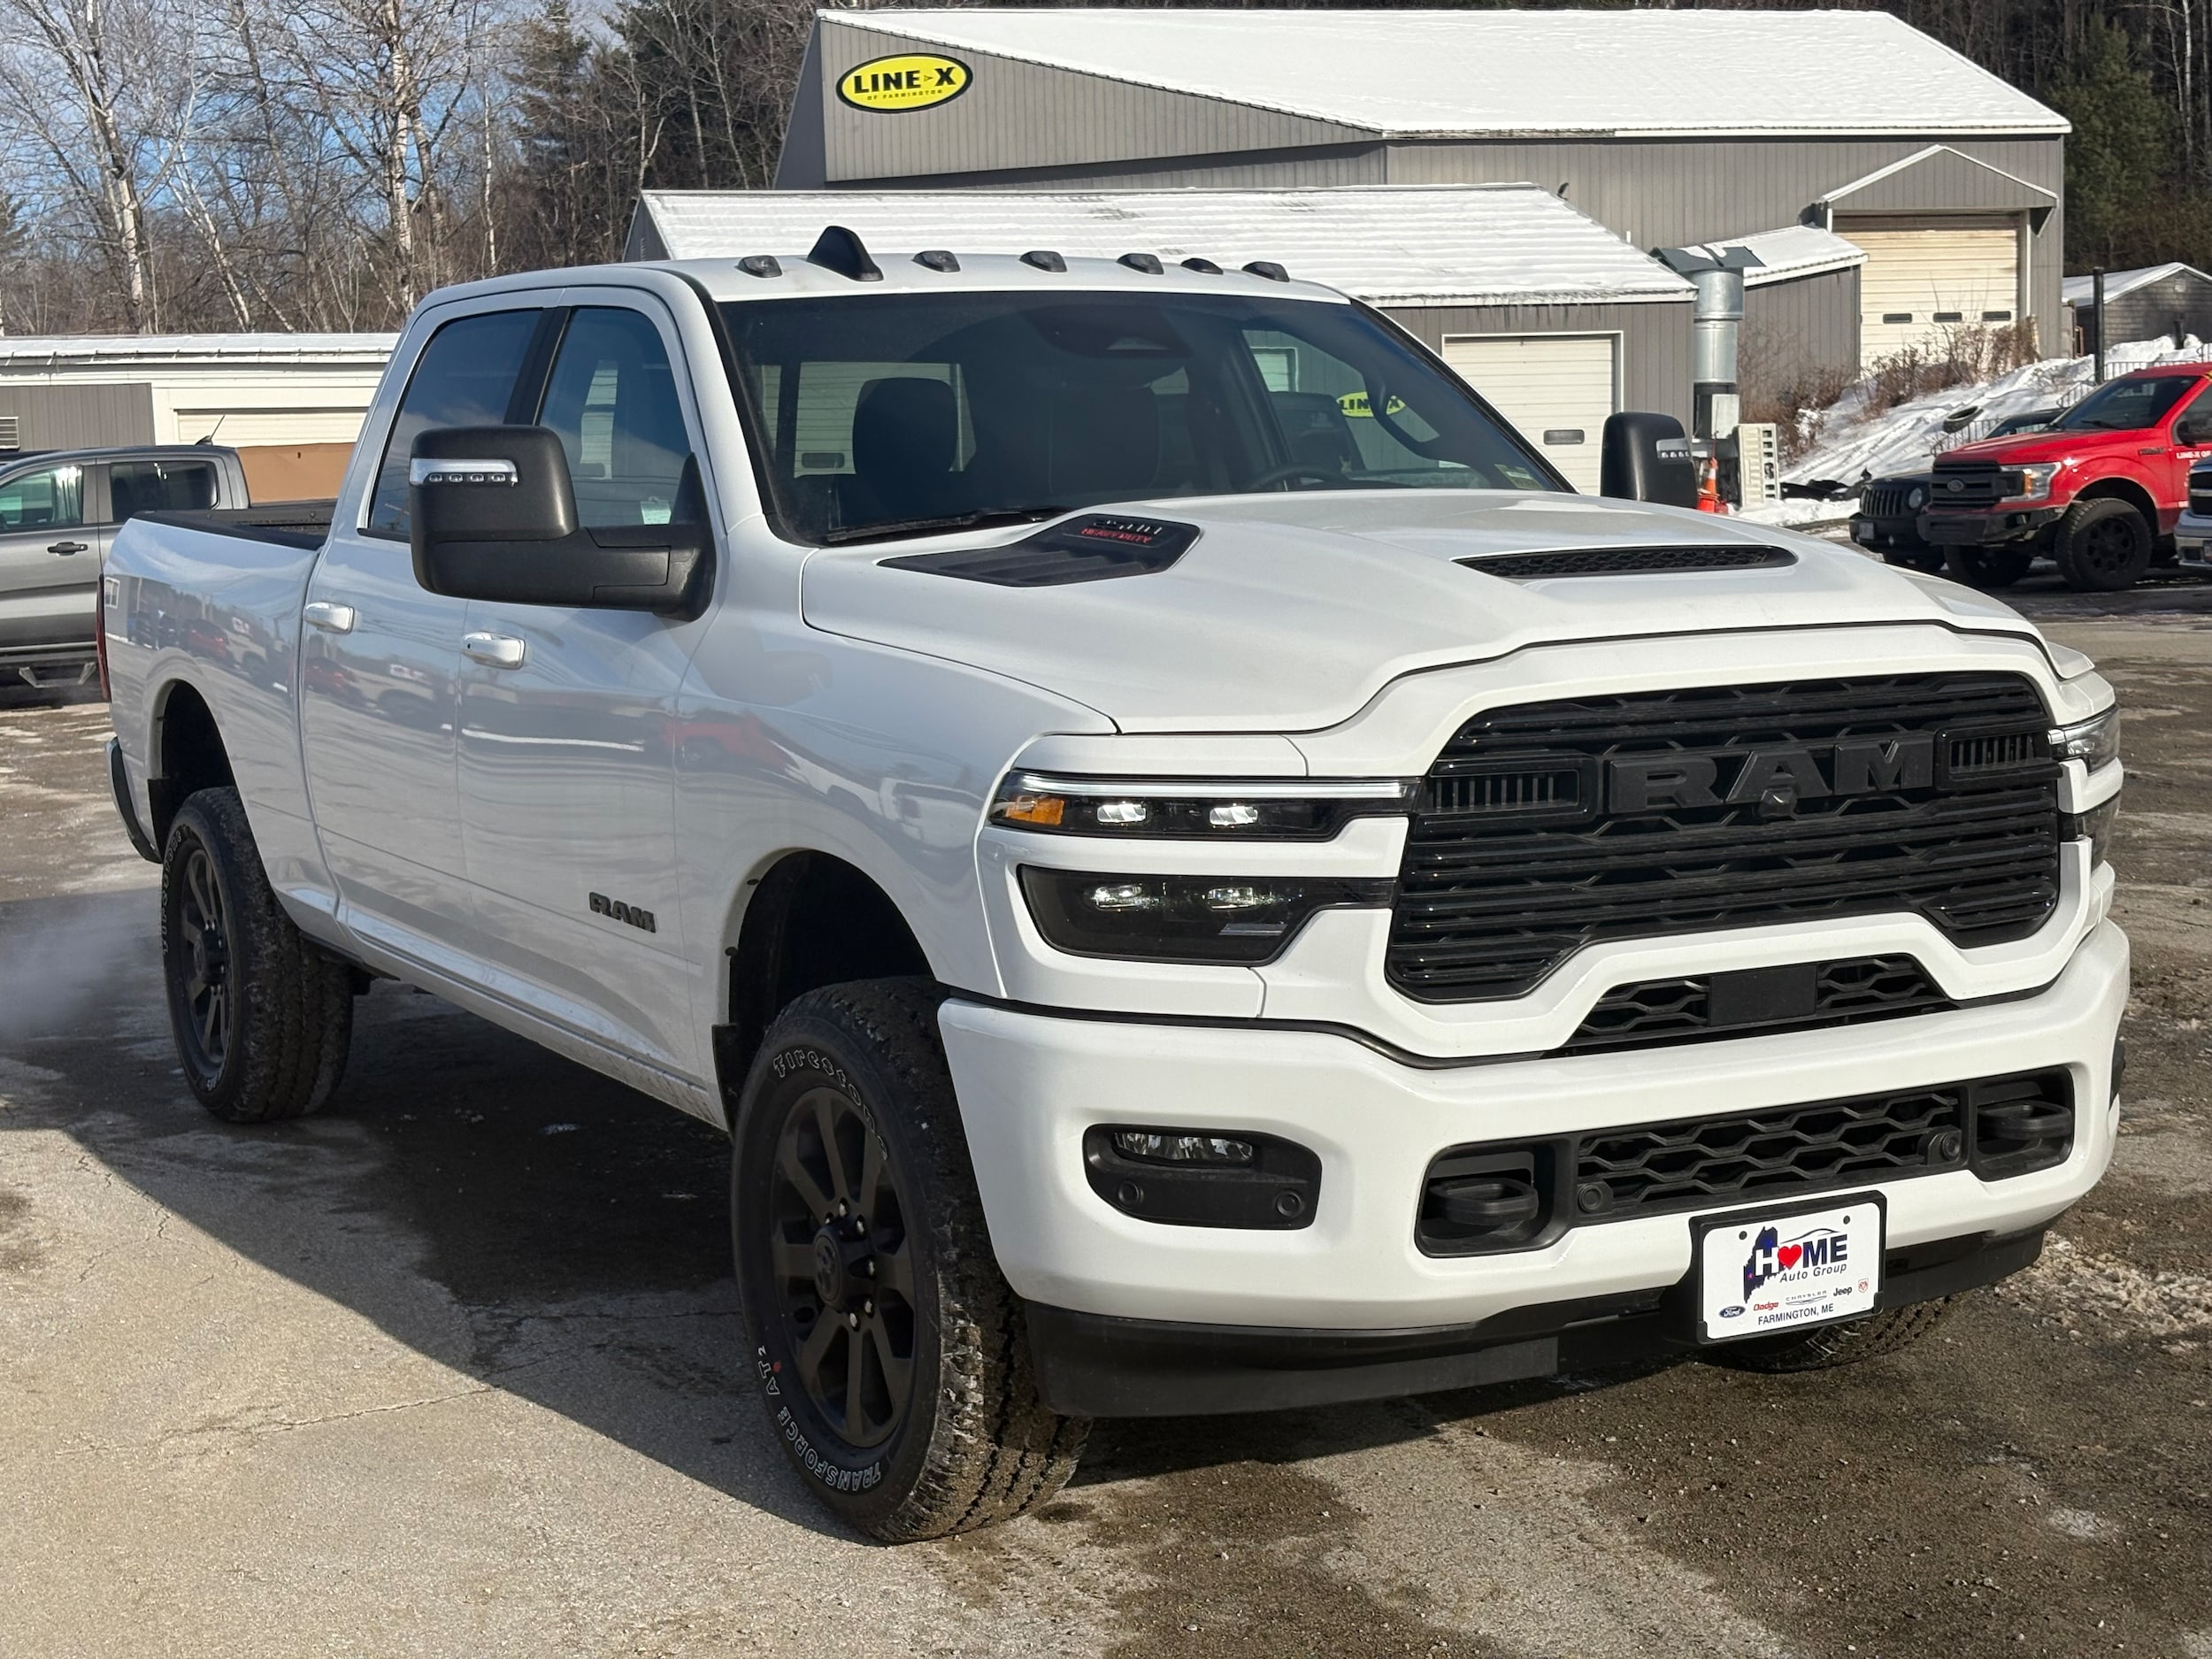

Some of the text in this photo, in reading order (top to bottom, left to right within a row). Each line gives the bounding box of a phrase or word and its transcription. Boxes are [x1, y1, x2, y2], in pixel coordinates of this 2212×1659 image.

[854, 66, 956, 94] LINE-X
[1081, 528, 1152, 543] HEAVY DUTY
[1609, 734, 1934, 814] RAM
[588, 891, 657, 933] RAM
[772, 1049, 887, 1161] Firestone
[1779, 1263, 1847, 1283] Auto Group
[1753, 1301, 1779, 1311] Dodge
[1785, 1289, 1827, 1302] CHRYSLER
[1832, 1285, 1853, 1297] Jeep
[1758, 1303, 1834, 1325] FARMINGTON, ME
[777, 1406, 882, 1491] TRANSFORCE
